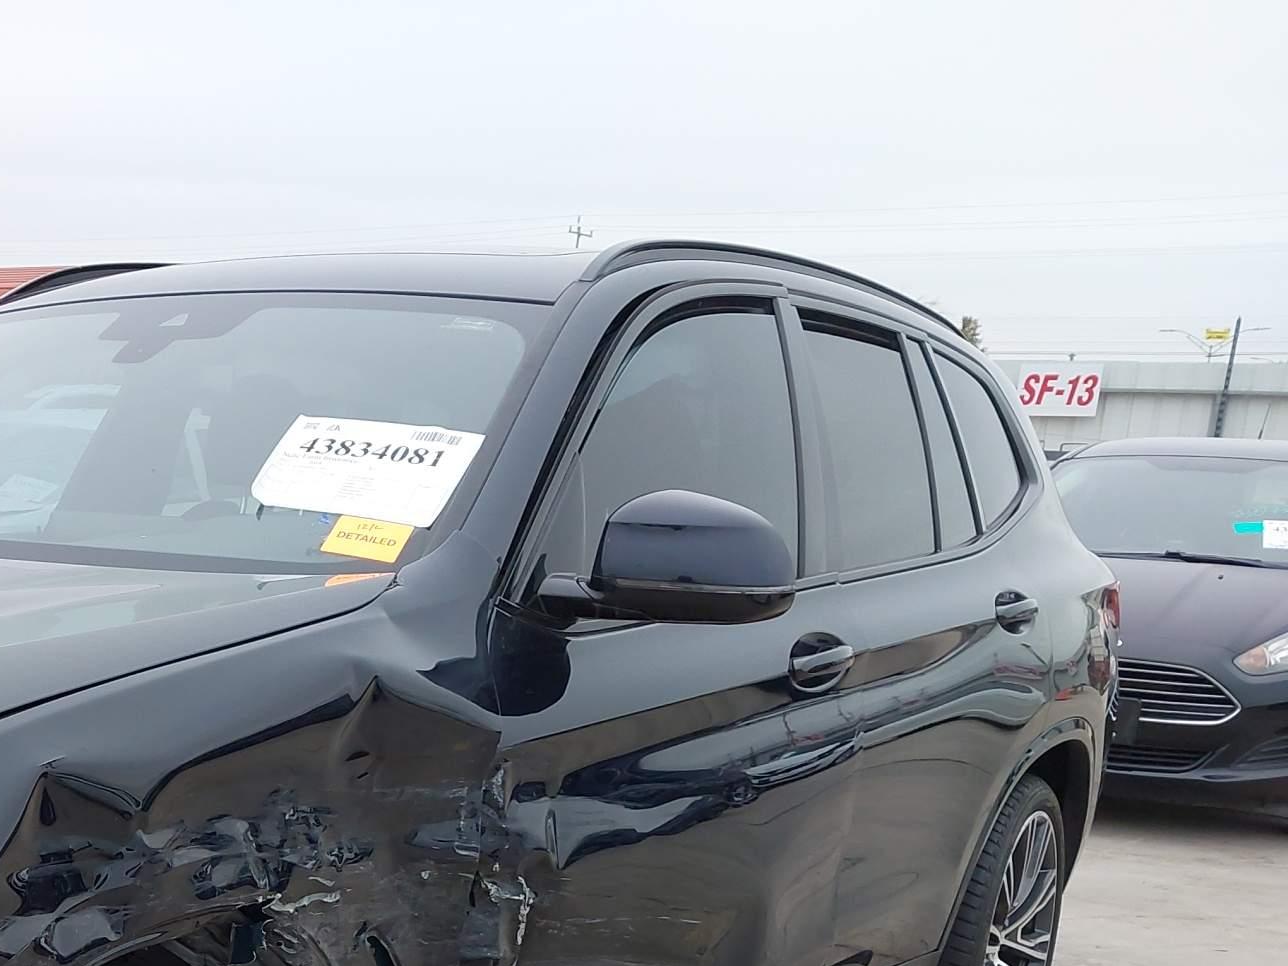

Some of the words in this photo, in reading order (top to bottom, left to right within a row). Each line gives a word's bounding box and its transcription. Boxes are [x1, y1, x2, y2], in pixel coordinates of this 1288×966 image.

[1019, 373, 1099, 406] SF-13
[299, 437, 446, 468] 43834081
[336, 530, 398, 547] DETAILED
